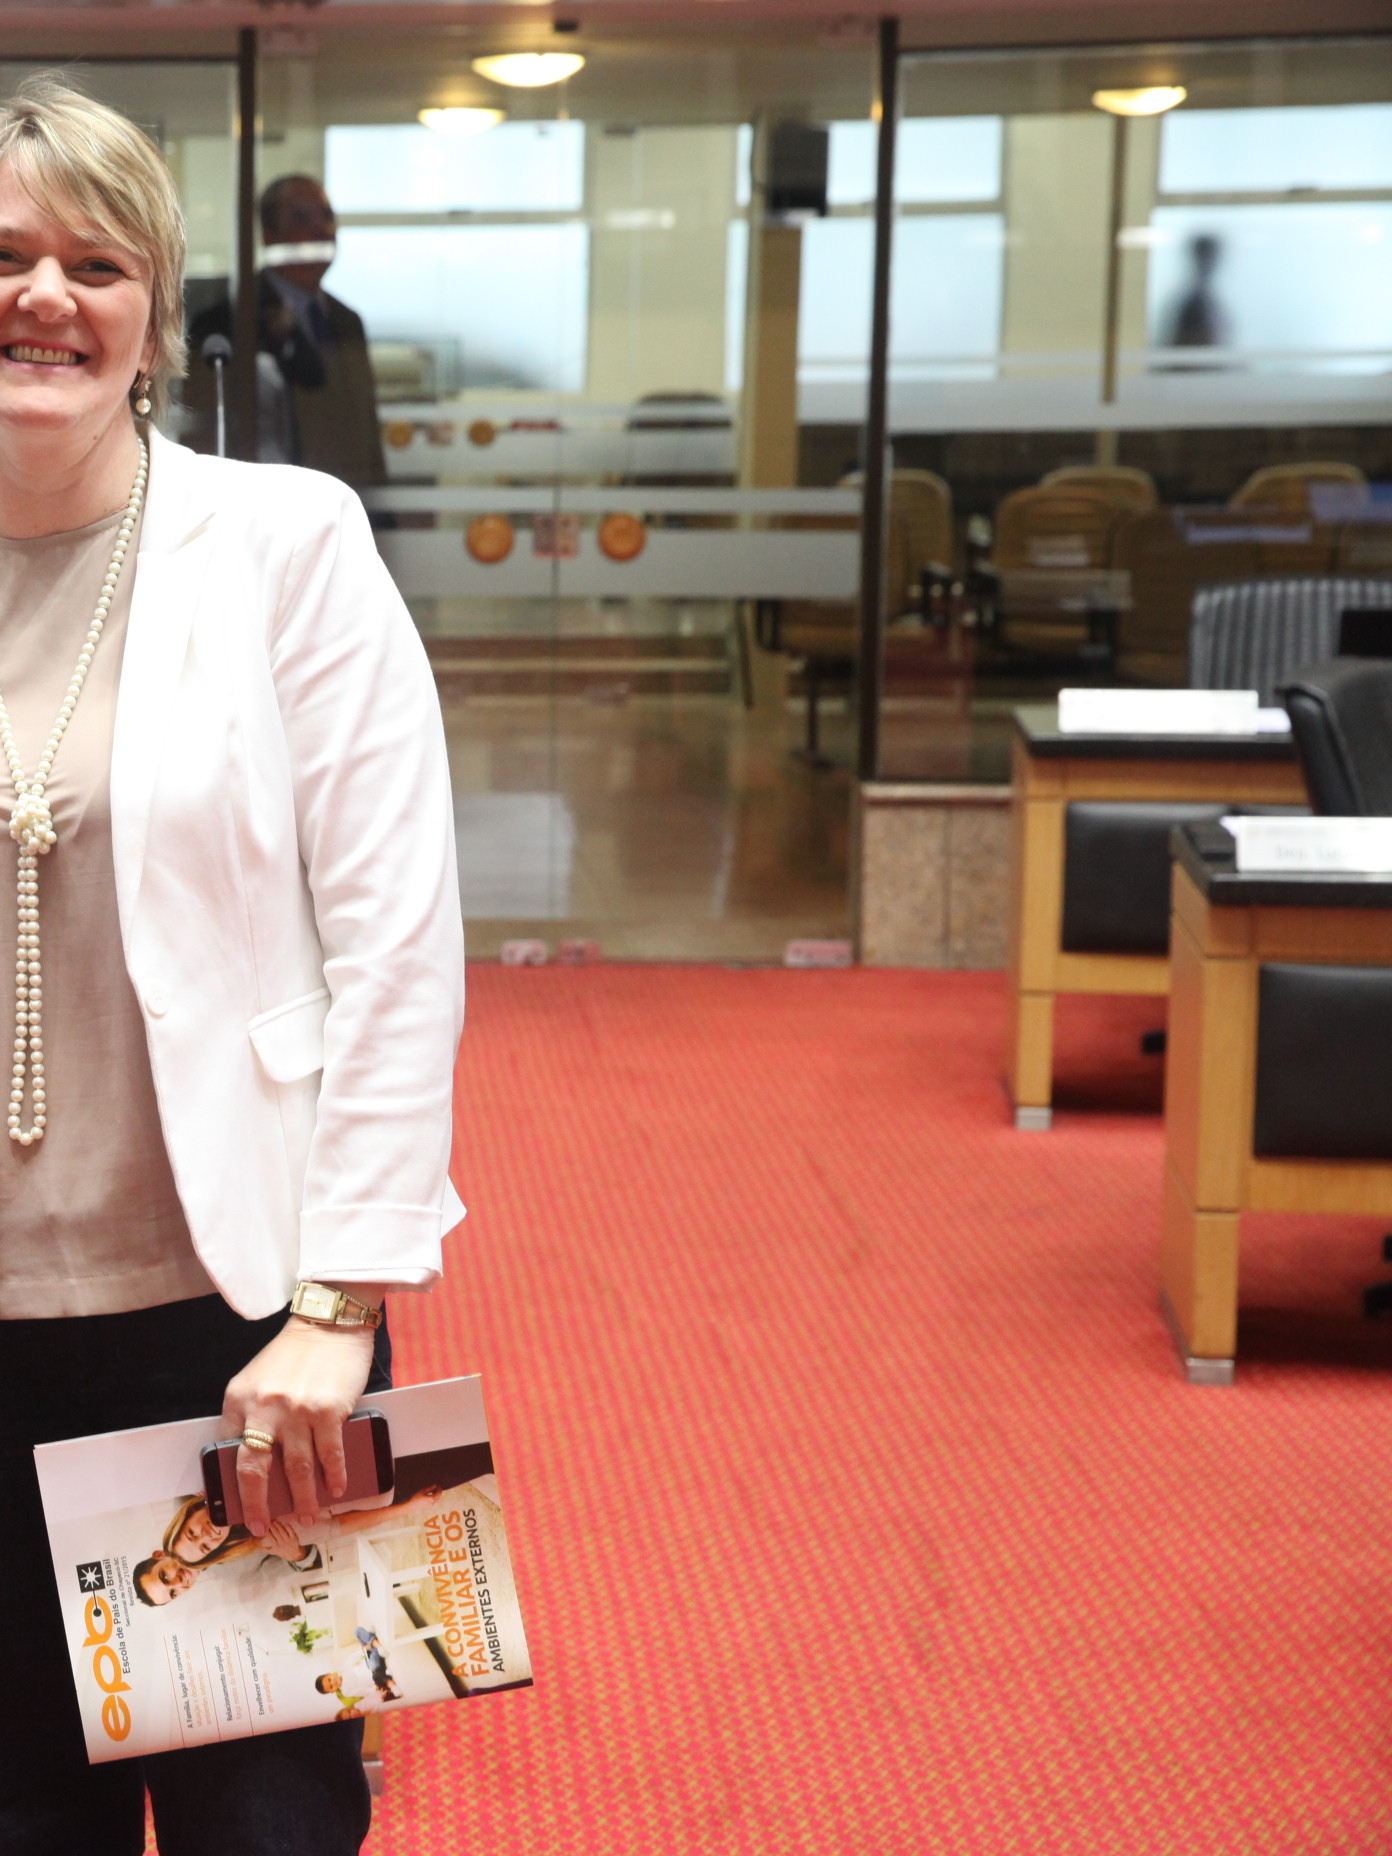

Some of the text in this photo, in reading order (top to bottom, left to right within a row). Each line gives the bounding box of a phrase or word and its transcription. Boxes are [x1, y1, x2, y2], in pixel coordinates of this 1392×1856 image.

[120, 1555, 129, 1578] 21/2015
[423, 1515, 469, 1677] A CONVIVÊNCIA
[442, 1511, 489, 1676] FAMILIAR E OS
[464, 1508, 505, 1672] AMBIENTES EXTERNOS
[102, 1558, 130, 1673] Escola de Pais do Brasil
[172, 1635, 182, 1671] convivência:
[245, 1635, 256, 1666] qualidade:
[83, 1596, 131, 1742] epb
[220, 1674, 233, 1721] Relacionamento
[255, 1683, 264, 1715] Envelhecer
